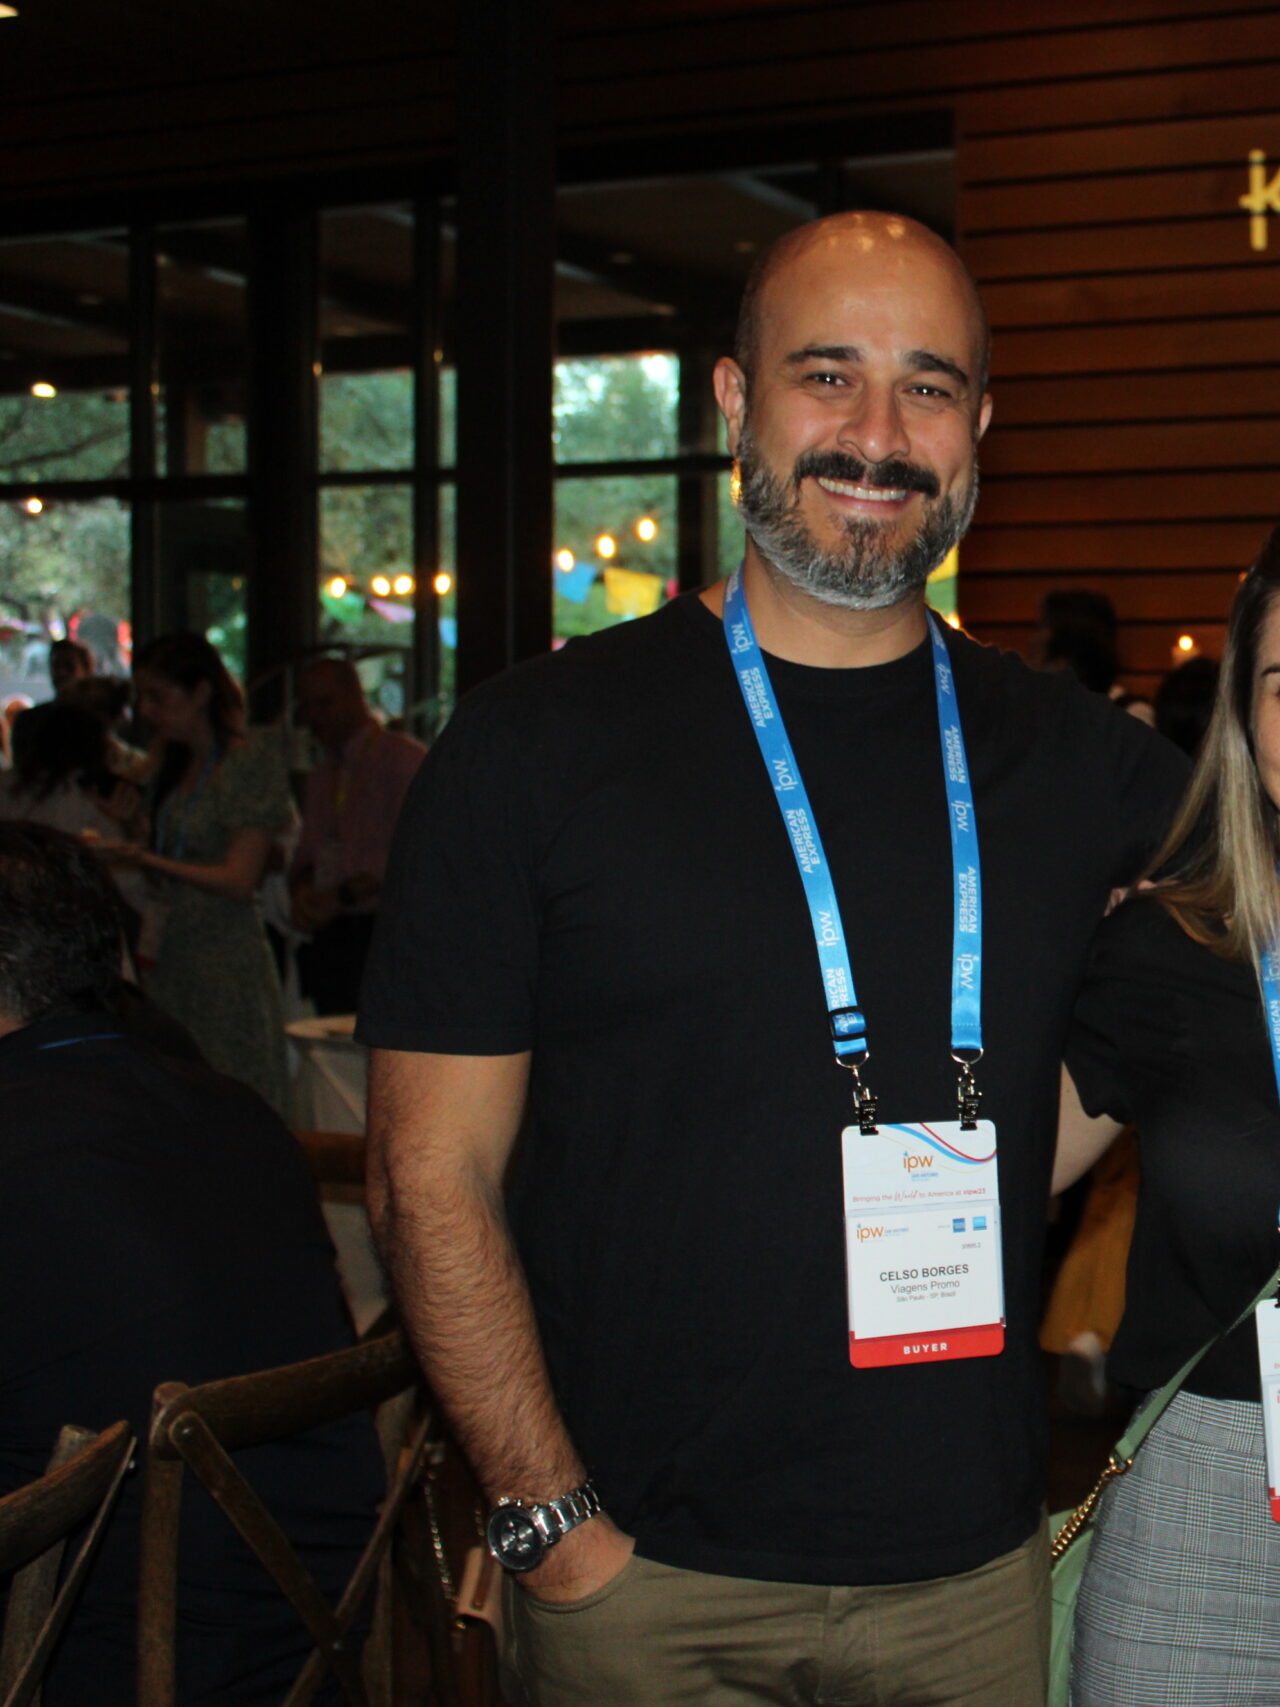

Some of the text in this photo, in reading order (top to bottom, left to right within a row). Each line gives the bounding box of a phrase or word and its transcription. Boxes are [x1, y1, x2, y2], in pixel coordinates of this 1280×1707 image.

[730, 624, 754, 654] ipw
[740, 669, 766, 728] AMERICAN
[750, 667, 774, 720] EXPRESS
[944, 729, 959, 782] EXPRESS
[950, 724, 966, 784] AMERICAN
[772, 759, 799, 791] ipw
[951, 800, 972, 832] ipw
[786, 809, 813, 874] AMERICAN
[795, 808, 821, 865] EXPRESS
[958, 873, 968, 933] EXPRESS
[967, 866, 977, 934] AMERICAN
[817, 911, 840, 946] ipw
[957, 953, 980, 990] ipw
[903, 1150, 934, 1173] ipw
[856, 1223, 884, 1243] ipw
[880, 1264, 969, 1282] CELSO BORGES
[891, 1280, 960, 1294] Viagens Promo
[903, 1342, 948, 1355] BUYER
